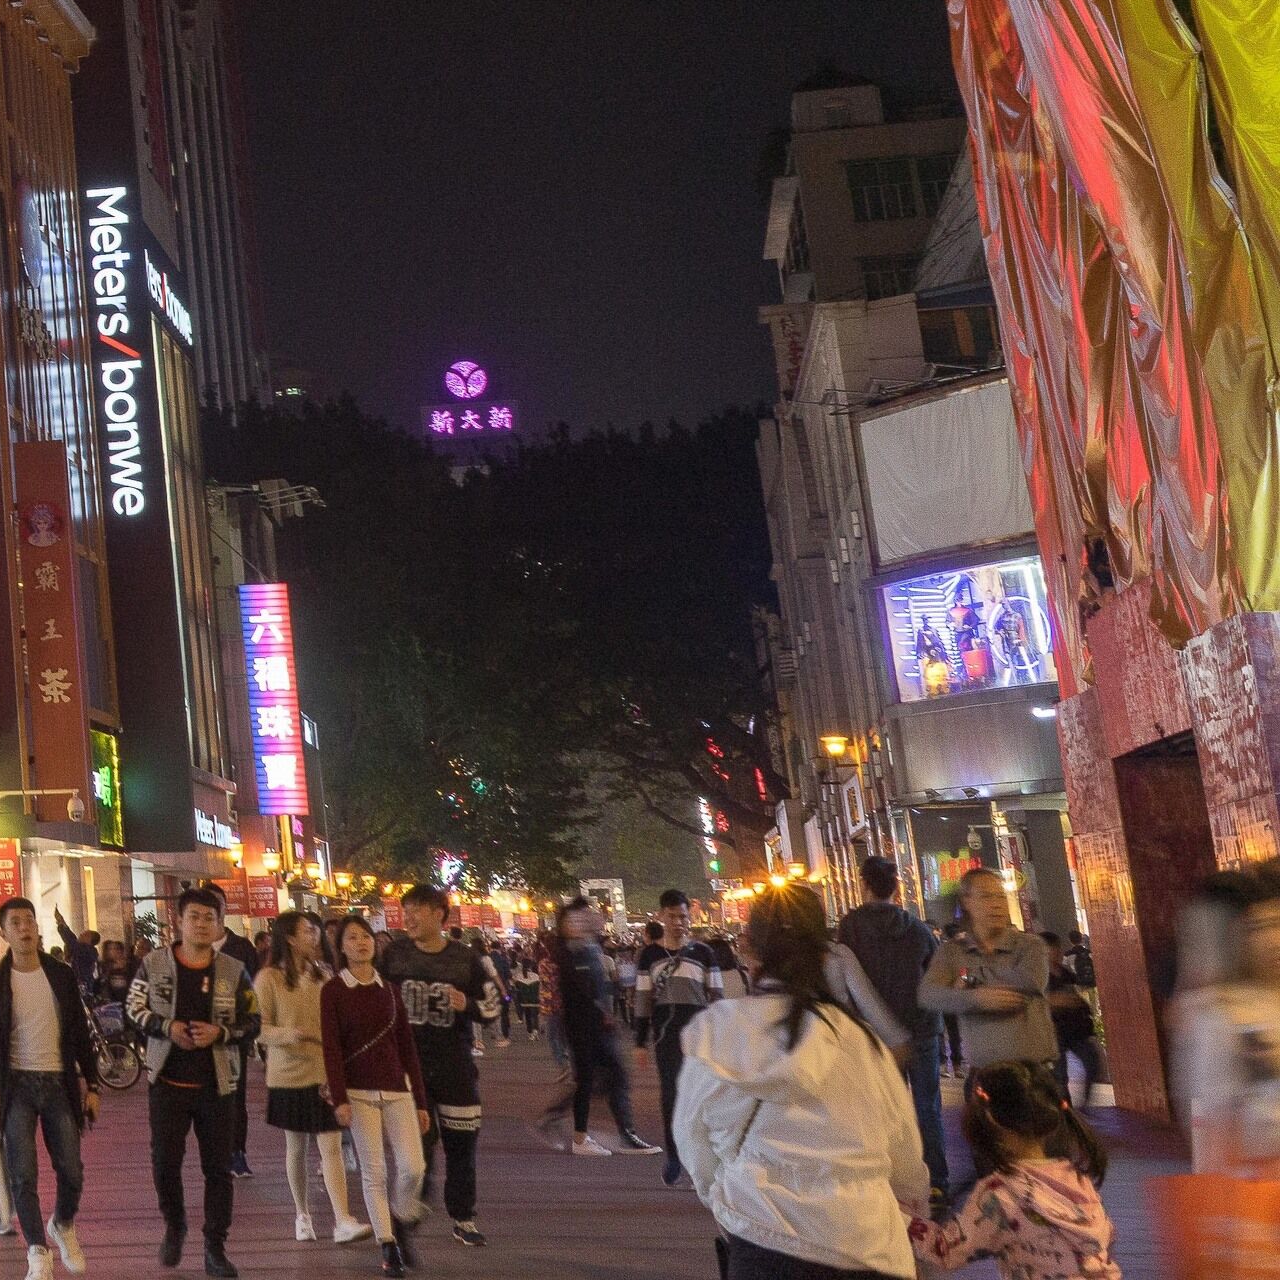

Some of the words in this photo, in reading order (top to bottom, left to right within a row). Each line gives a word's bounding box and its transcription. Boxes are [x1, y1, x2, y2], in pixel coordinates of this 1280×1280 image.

[86, 186, 145, 517] Meters/bonwe
[32, 562, 72, 704] 霸王茶
